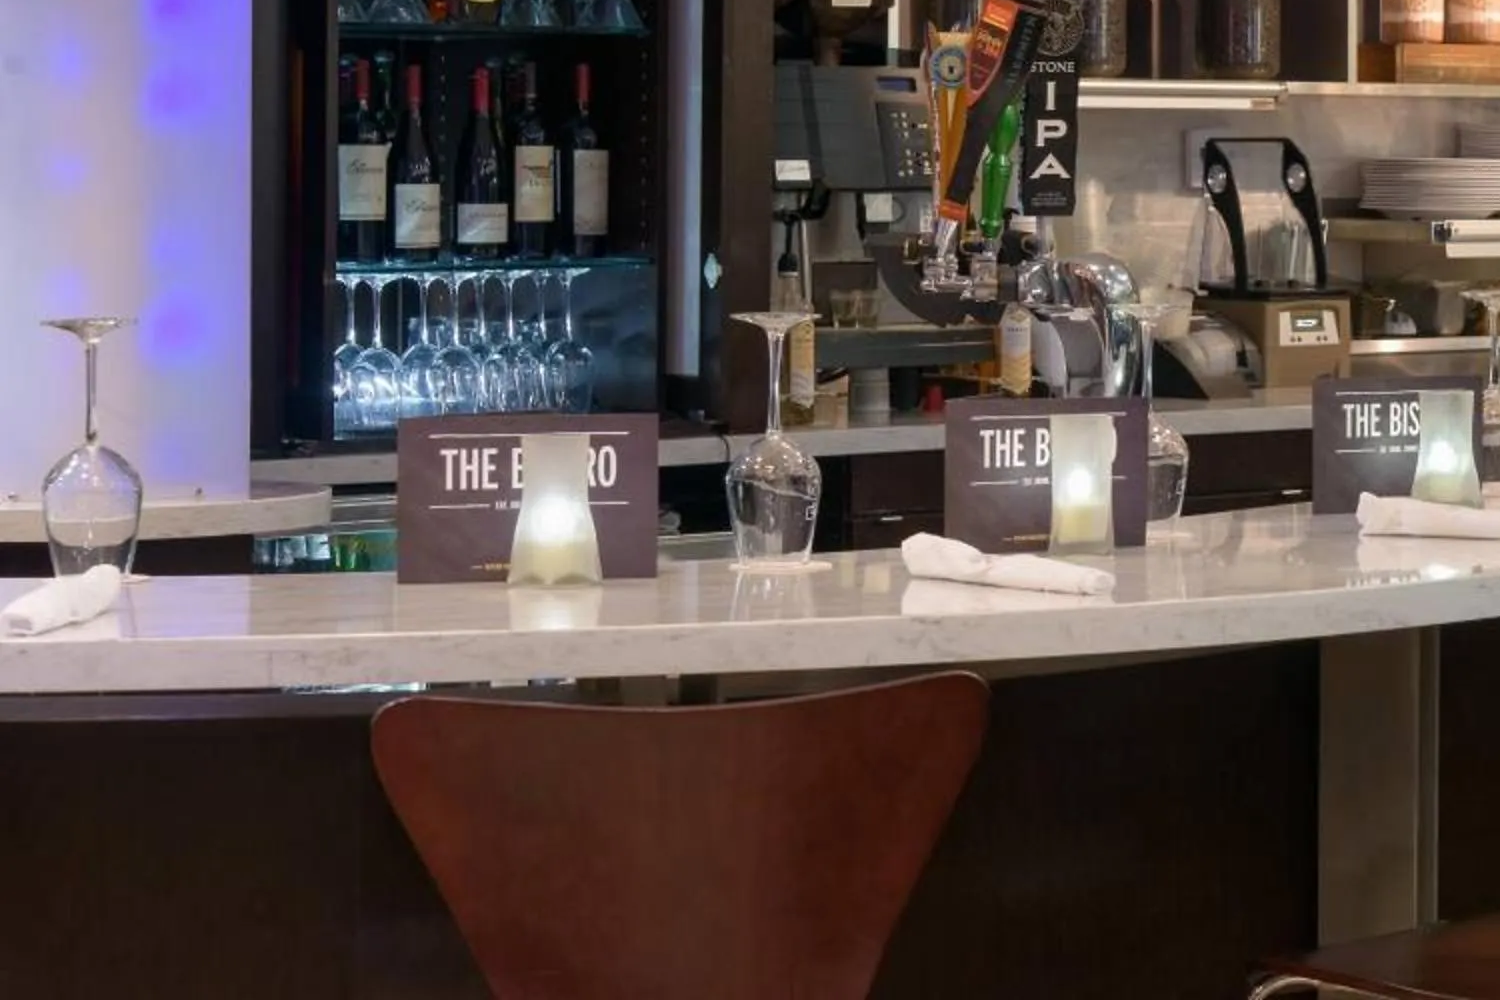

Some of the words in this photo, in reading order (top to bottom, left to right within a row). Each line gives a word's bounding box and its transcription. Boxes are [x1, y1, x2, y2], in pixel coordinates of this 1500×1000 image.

[1031, 61, 1075, 73] STONE
[1343, 403, 1381, 438] THE
[1389, 402, 1420, 437] BIS
[980, 428, 1026, 468] THE
[440, 448, 499, 490] THE
[511, 445, 617, 489] BRO
